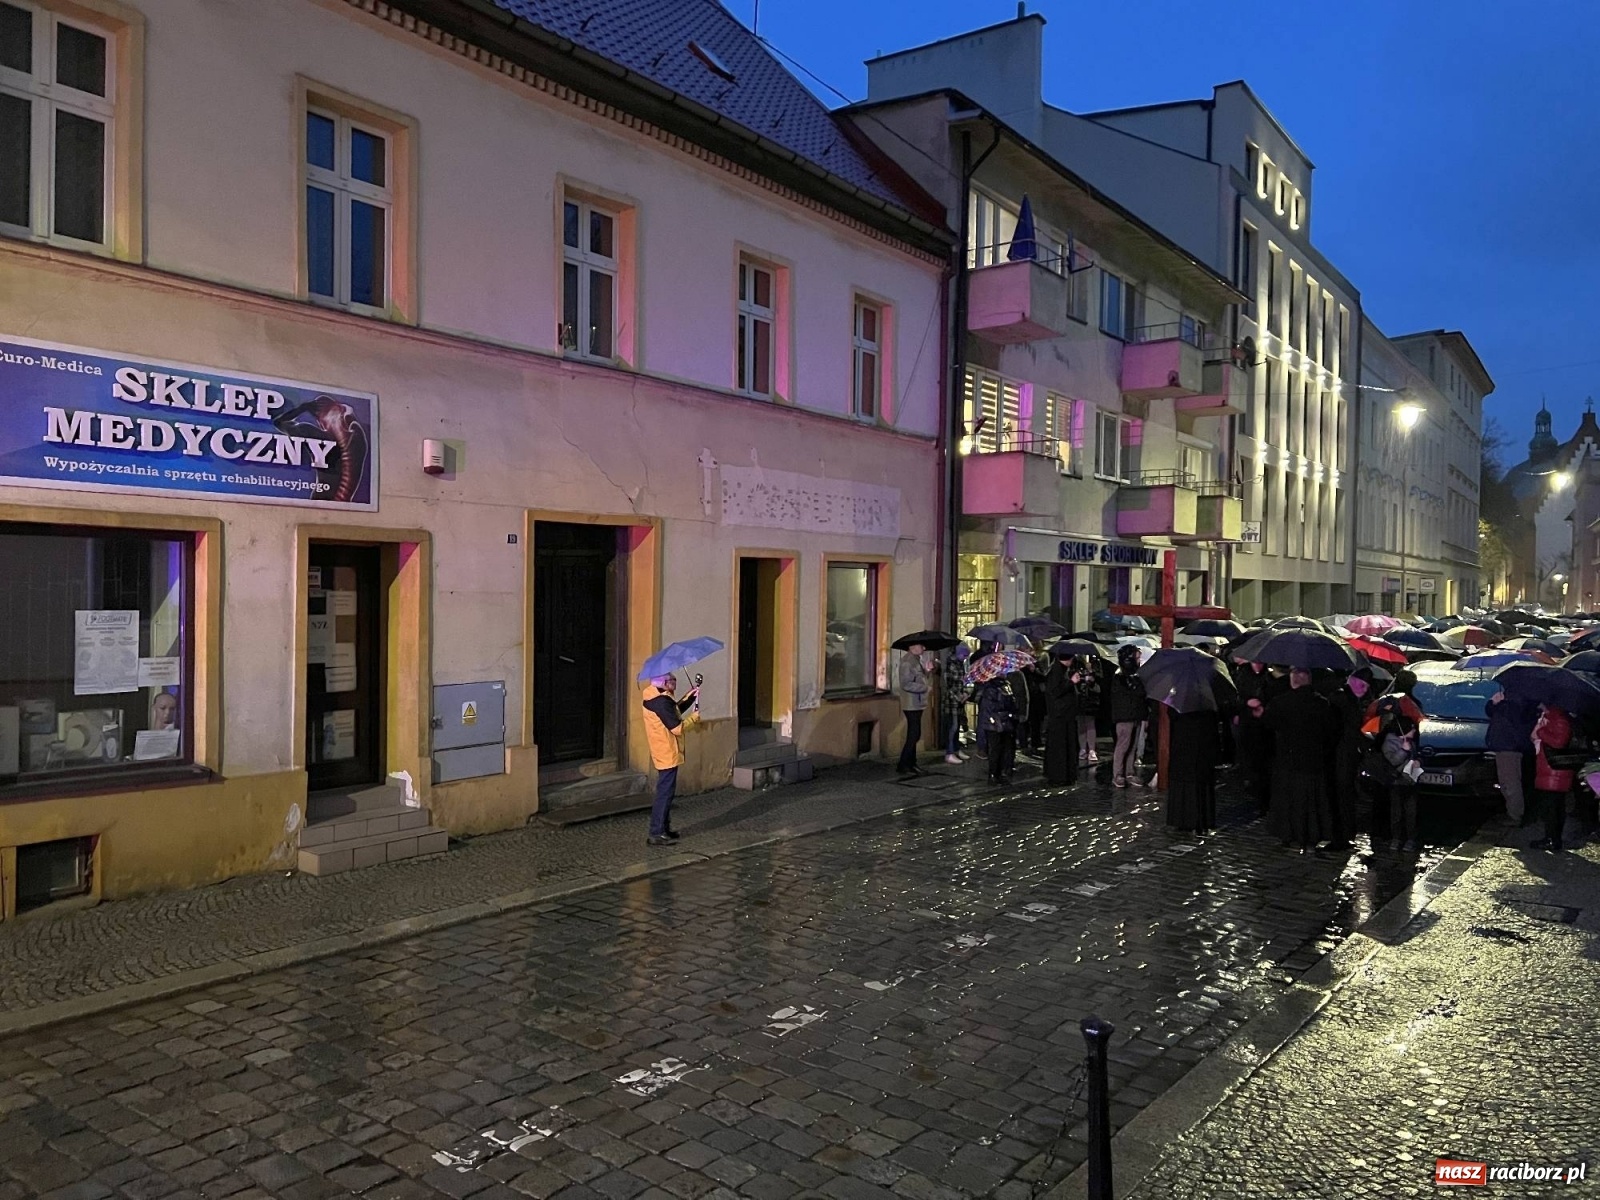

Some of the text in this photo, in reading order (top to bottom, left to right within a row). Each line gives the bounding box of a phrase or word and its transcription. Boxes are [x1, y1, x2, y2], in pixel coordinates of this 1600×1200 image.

[112, 366, 285, 420] SKLEP
[43, 406, 337, 469] MEDYCZNY
[43, 456, 331, 493] Wypożyczalnia sprzętu rehabilitacyjnego
[1062, 541, 1158, 564] SKLEP SPORTOWY
